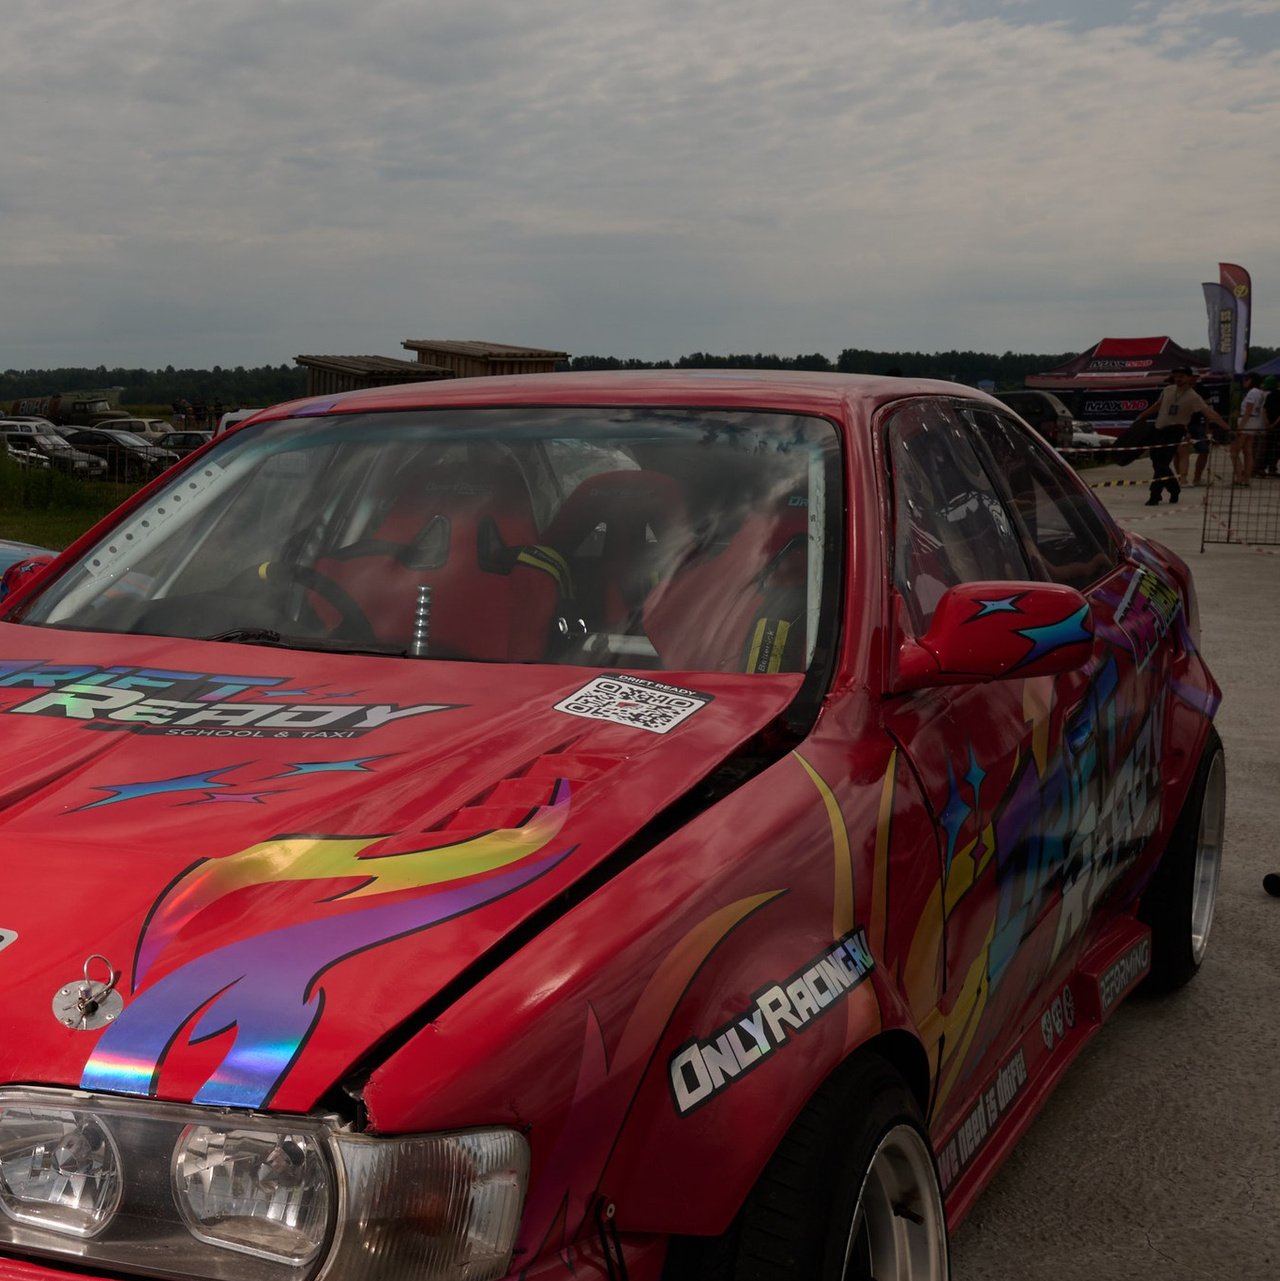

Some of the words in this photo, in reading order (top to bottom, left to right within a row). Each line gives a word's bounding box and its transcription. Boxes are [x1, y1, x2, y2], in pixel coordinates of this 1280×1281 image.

[618, 674, 656, 687] DRIFT
[654, 683, 697, 697] READY
[8, 684, 455, 728] READY
[165, 728, 265, 739] SCHOOL
[273, 730, 290, 739] &
[300, 730, 356, 739] TAXI
